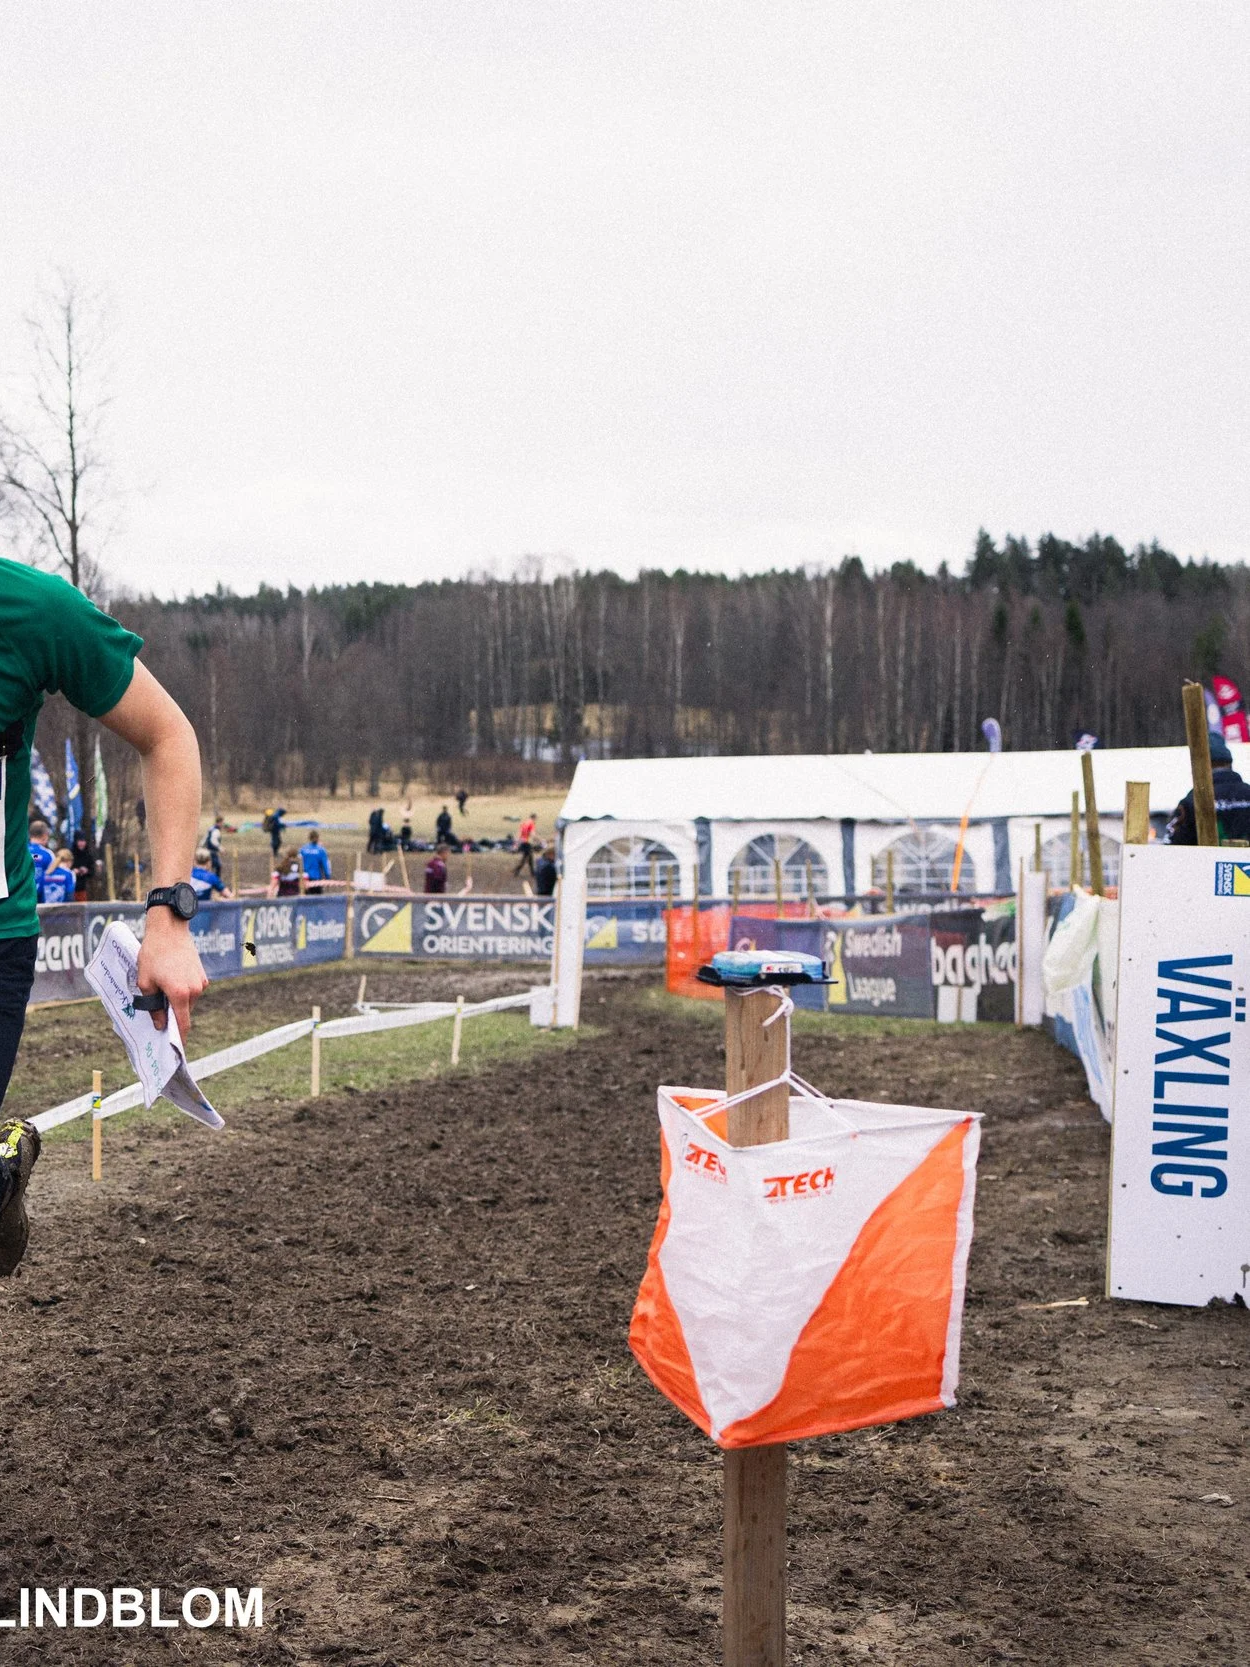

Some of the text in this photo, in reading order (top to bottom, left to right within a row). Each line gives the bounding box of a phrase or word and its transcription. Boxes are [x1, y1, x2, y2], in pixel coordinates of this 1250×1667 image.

[423, 901, 555, 932] SVENSK
[422, 934, 554, 954] ORIENTERING
[844, 924, 903, 957] Swedish
[848, 972, 897, 1007] League
[1150, 954, 1247, 1198] VÄXLING
